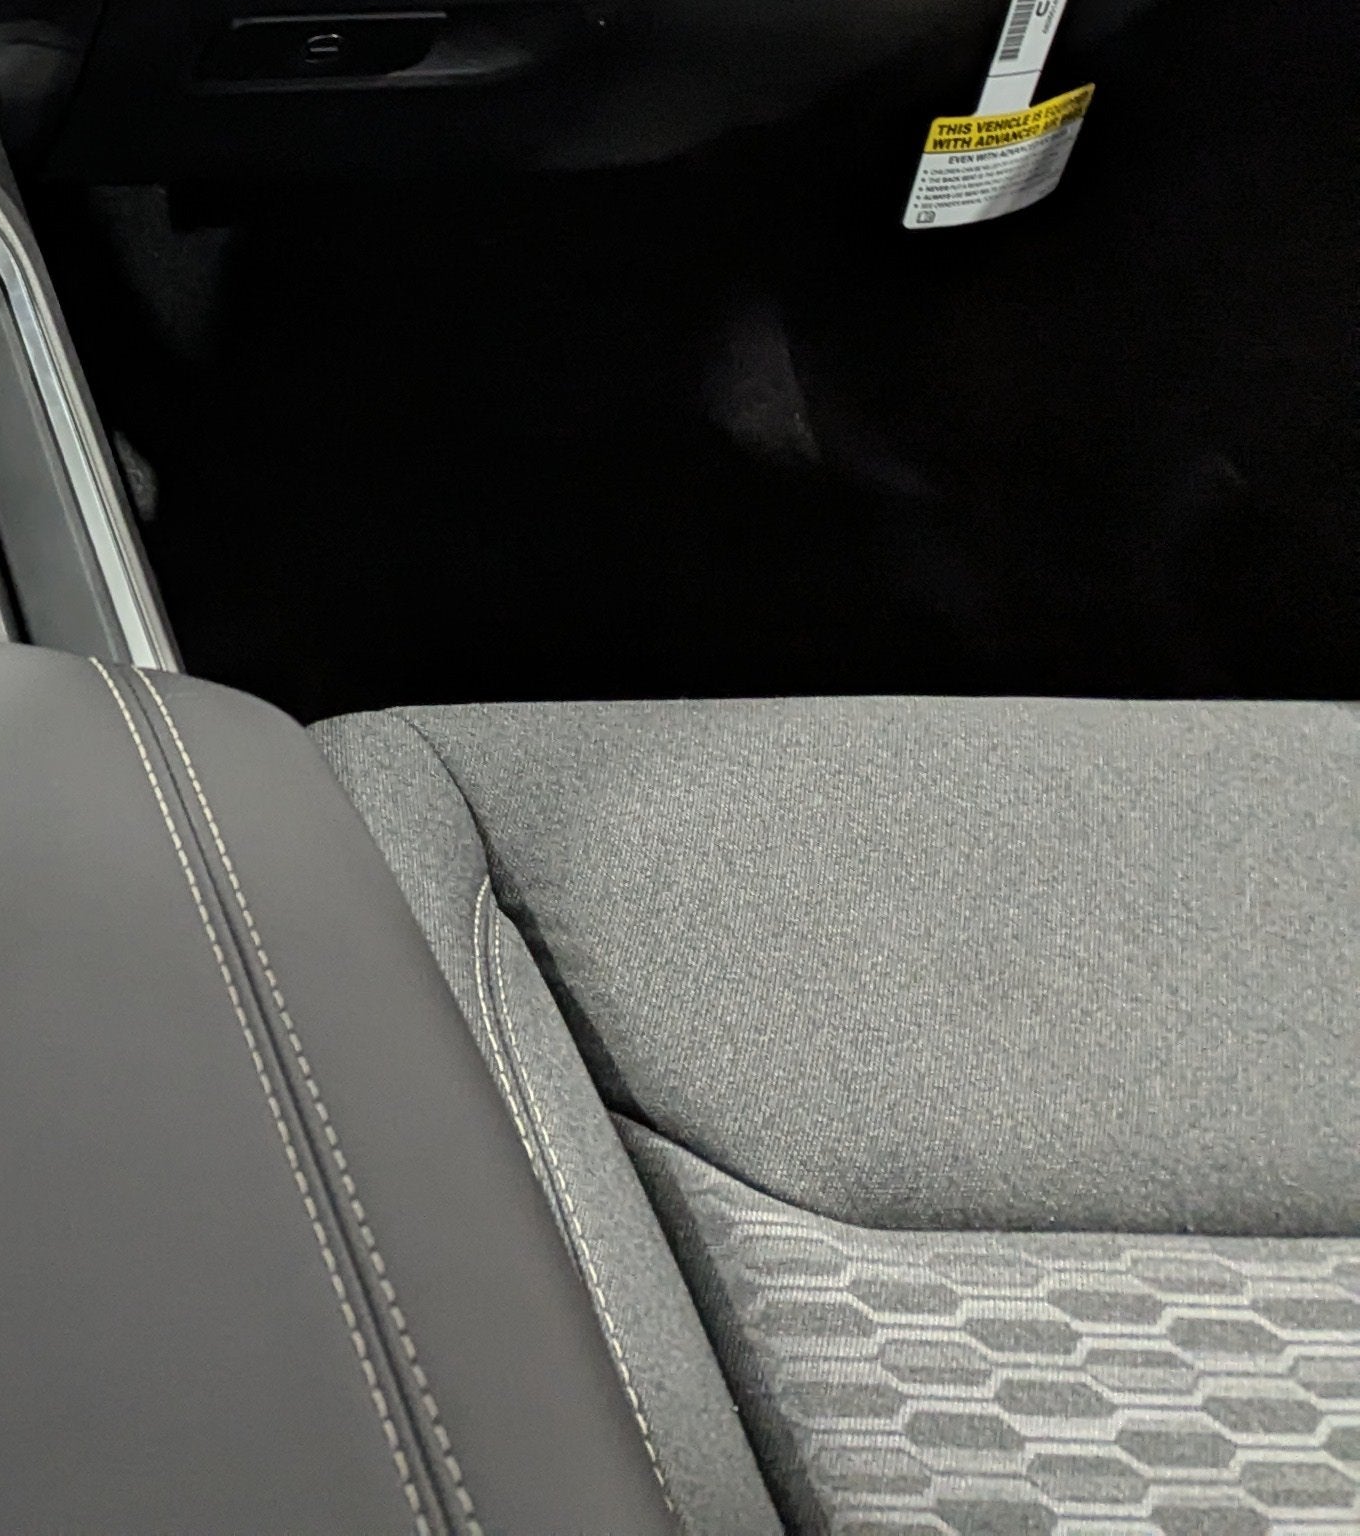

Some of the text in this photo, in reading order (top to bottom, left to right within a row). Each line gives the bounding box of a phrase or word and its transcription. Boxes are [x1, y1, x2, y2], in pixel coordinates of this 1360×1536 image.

[937, 123, 973, 136] THIS
[976, 115, 1029, 133] VEHICLE
[933, 137, 972, 150] WITH
[948, 155, 975, 165] EVEN
